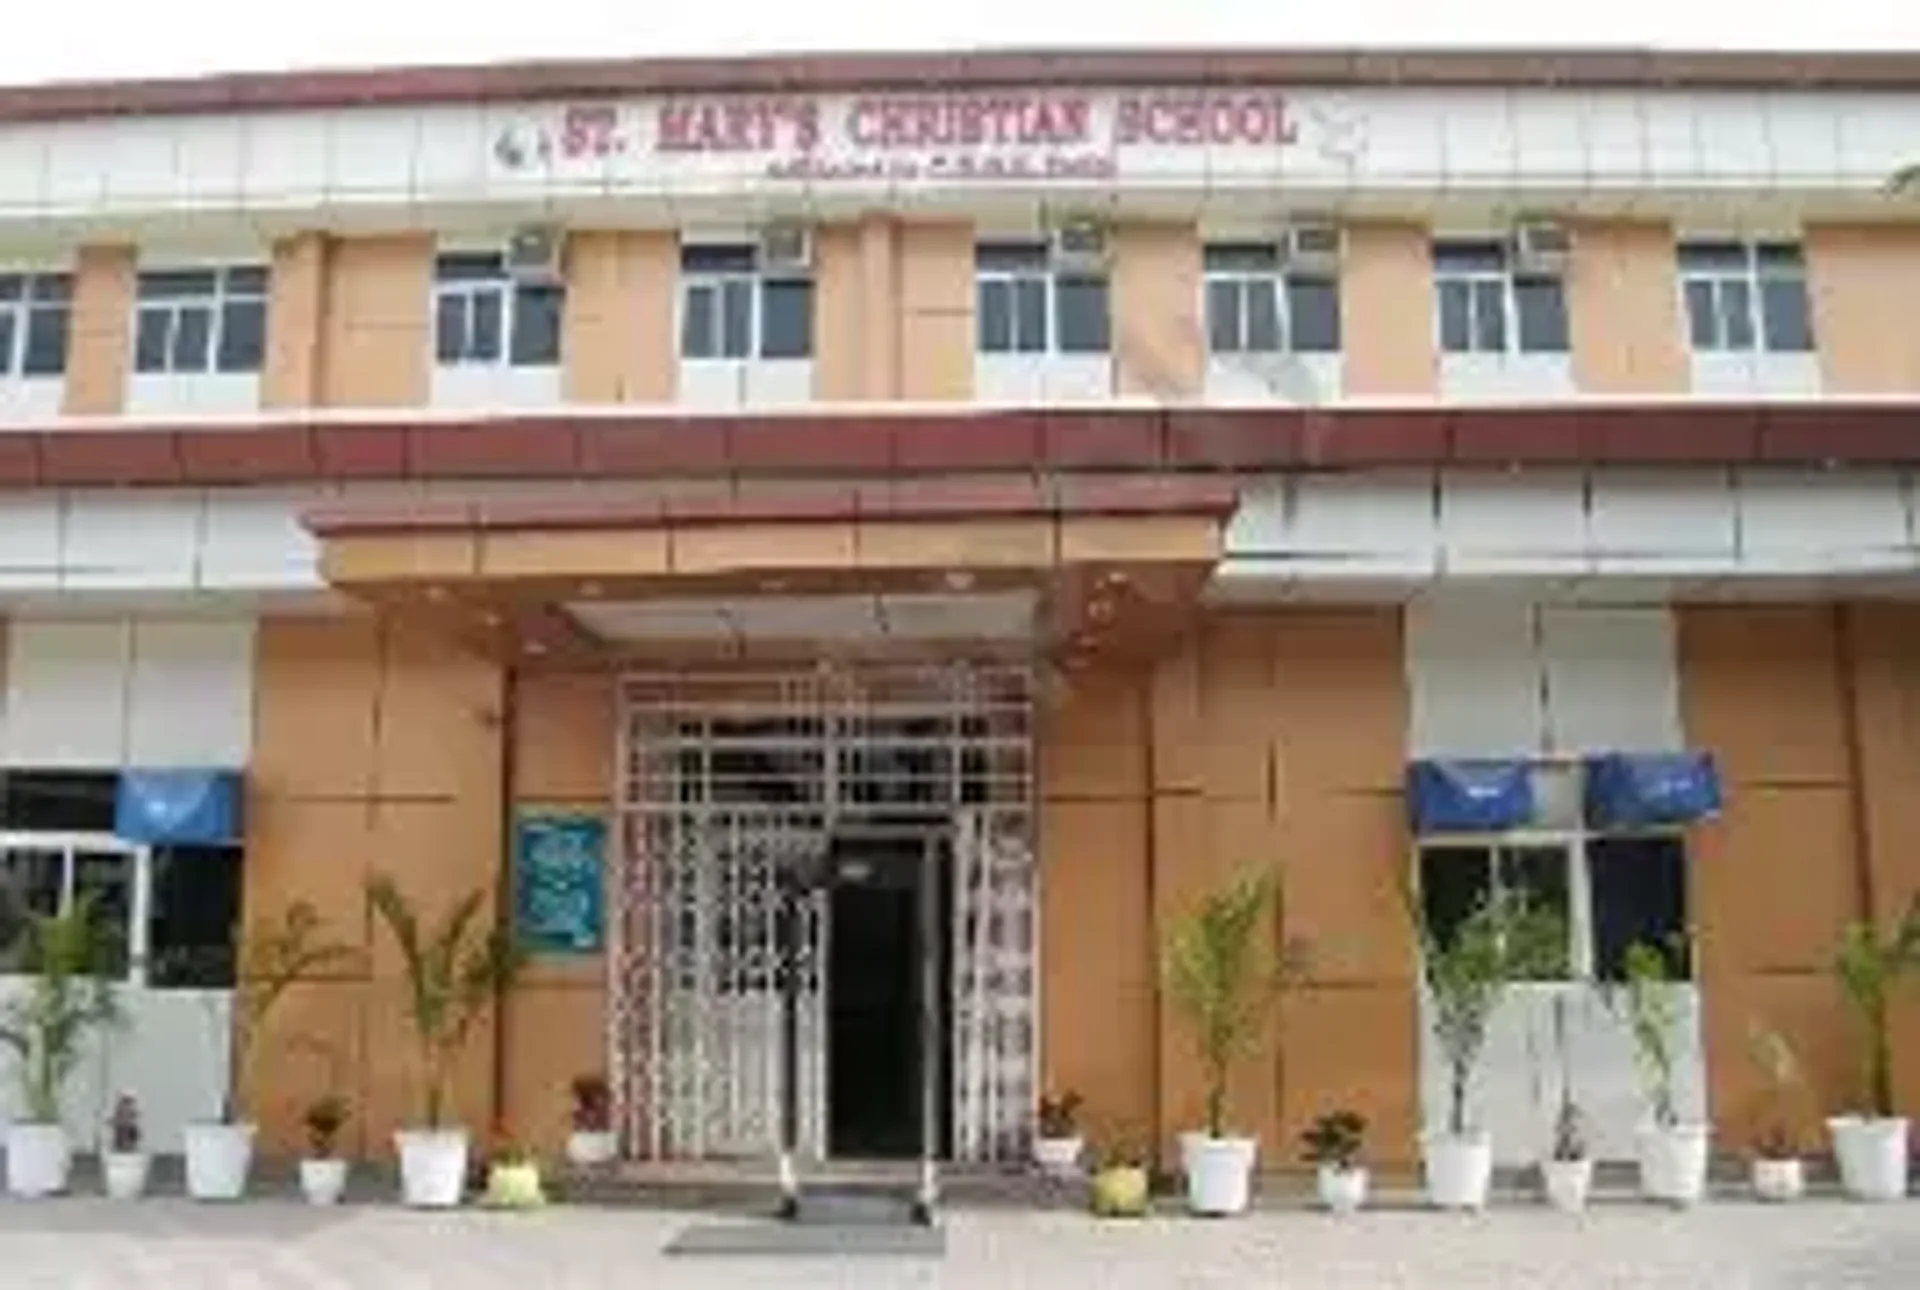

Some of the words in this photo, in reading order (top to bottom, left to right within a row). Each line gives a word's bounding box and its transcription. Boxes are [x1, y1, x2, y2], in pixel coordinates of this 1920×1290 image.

[560, 104, 626, 158] ST.
[656, 98, 820, 152] MARY'S
[847, 95, 1091, 146] CHRISTIAN
[1114, 92, 1298, 145] SCHOOL
